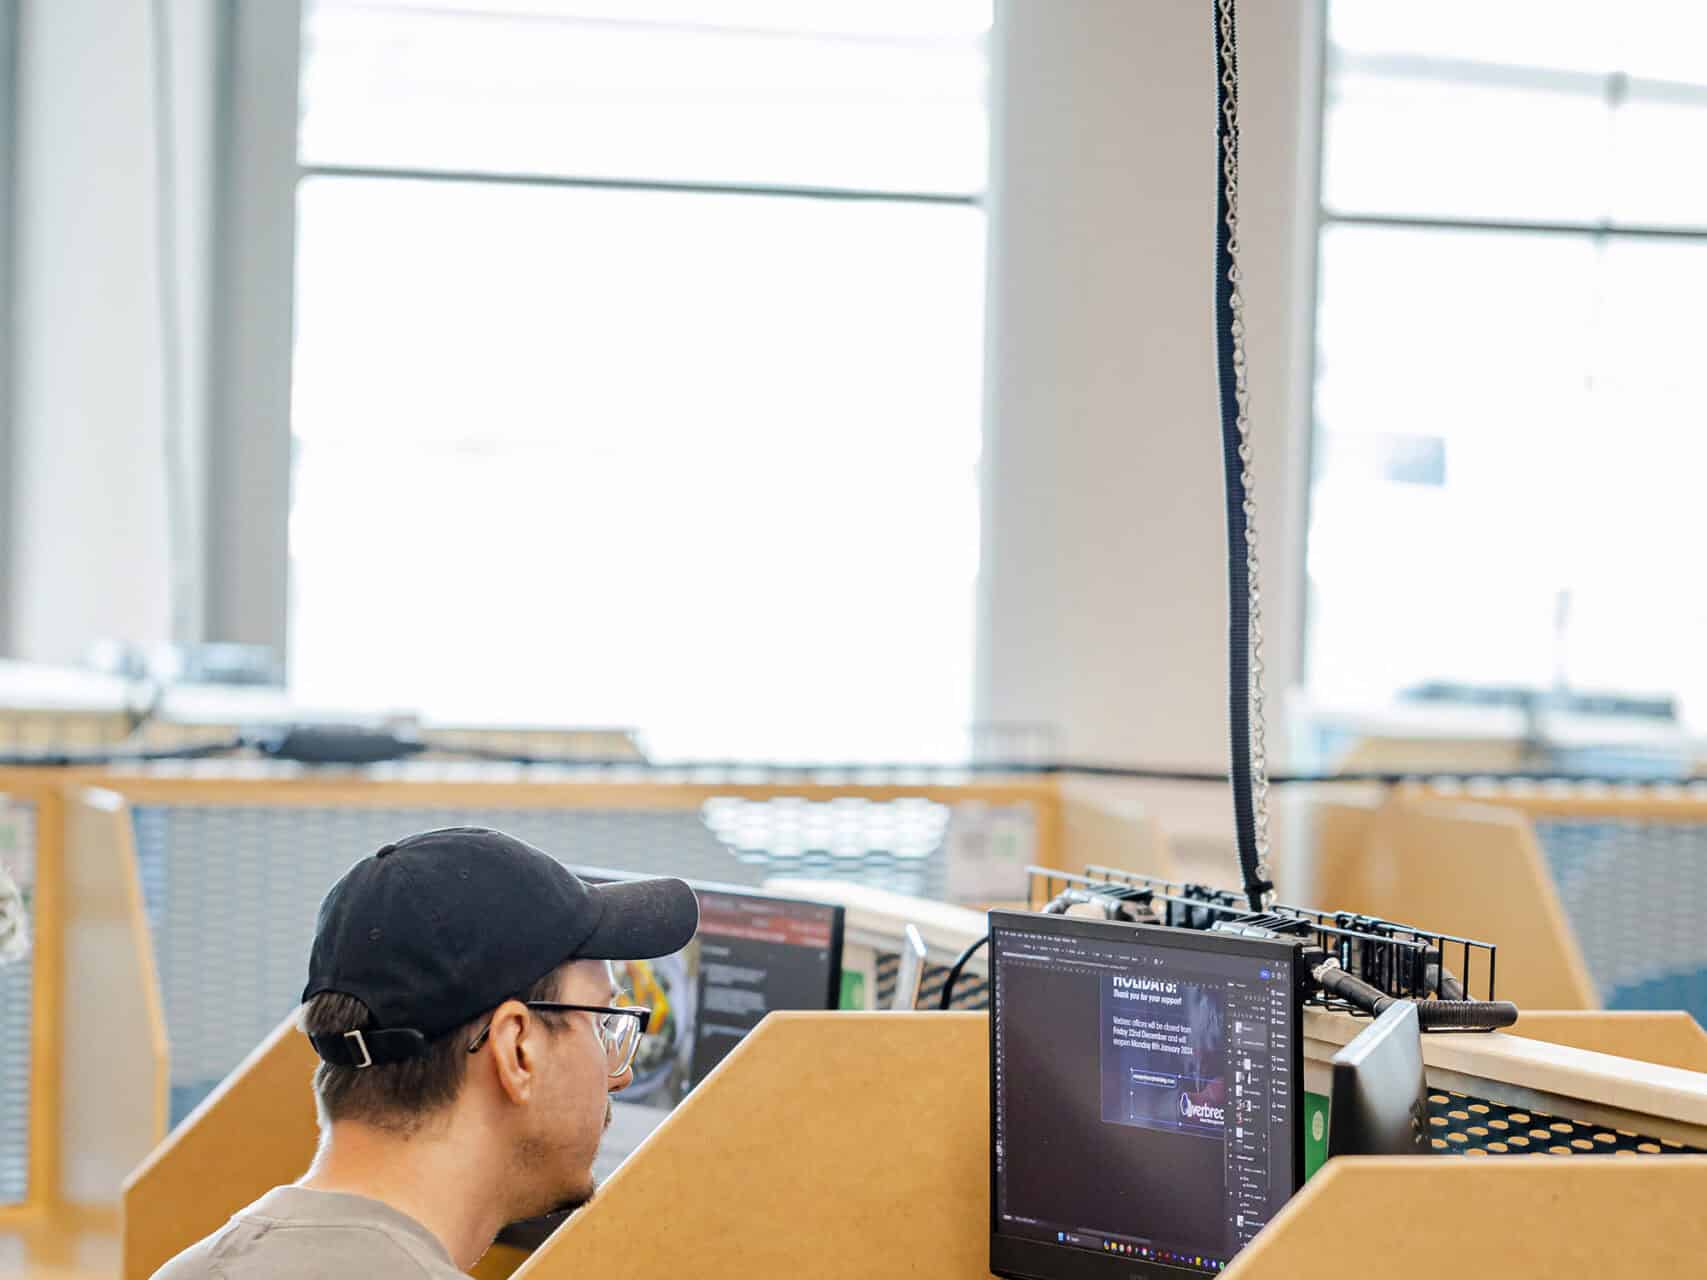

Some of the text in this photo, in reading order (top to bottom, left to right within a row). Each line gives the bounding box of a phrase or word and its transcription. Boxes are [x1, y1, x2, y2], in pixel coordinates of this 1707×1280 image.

[1113, 988, 1129, 999] Thank
[1130, 992, 1139, 1001] you
[1148, 995, 1160, 1003] your
[1161, 996, 1182, 1006] support
[1113, 1026, 1128, 1038] Friday
[1141, 1030, 1167, 1041] December
[1167, 1034, 1178, 1043] and
[1178, 1036, 1187, 1044] will
[1156, 1022, 1163, 1030] be
[1163, 1023, 1180, 1033] closed
[1181, 1025, 1192, 1034] from
[1131, 1040, 1151, 1051] Monday
[1161, 1044, 1180, 1055] January
